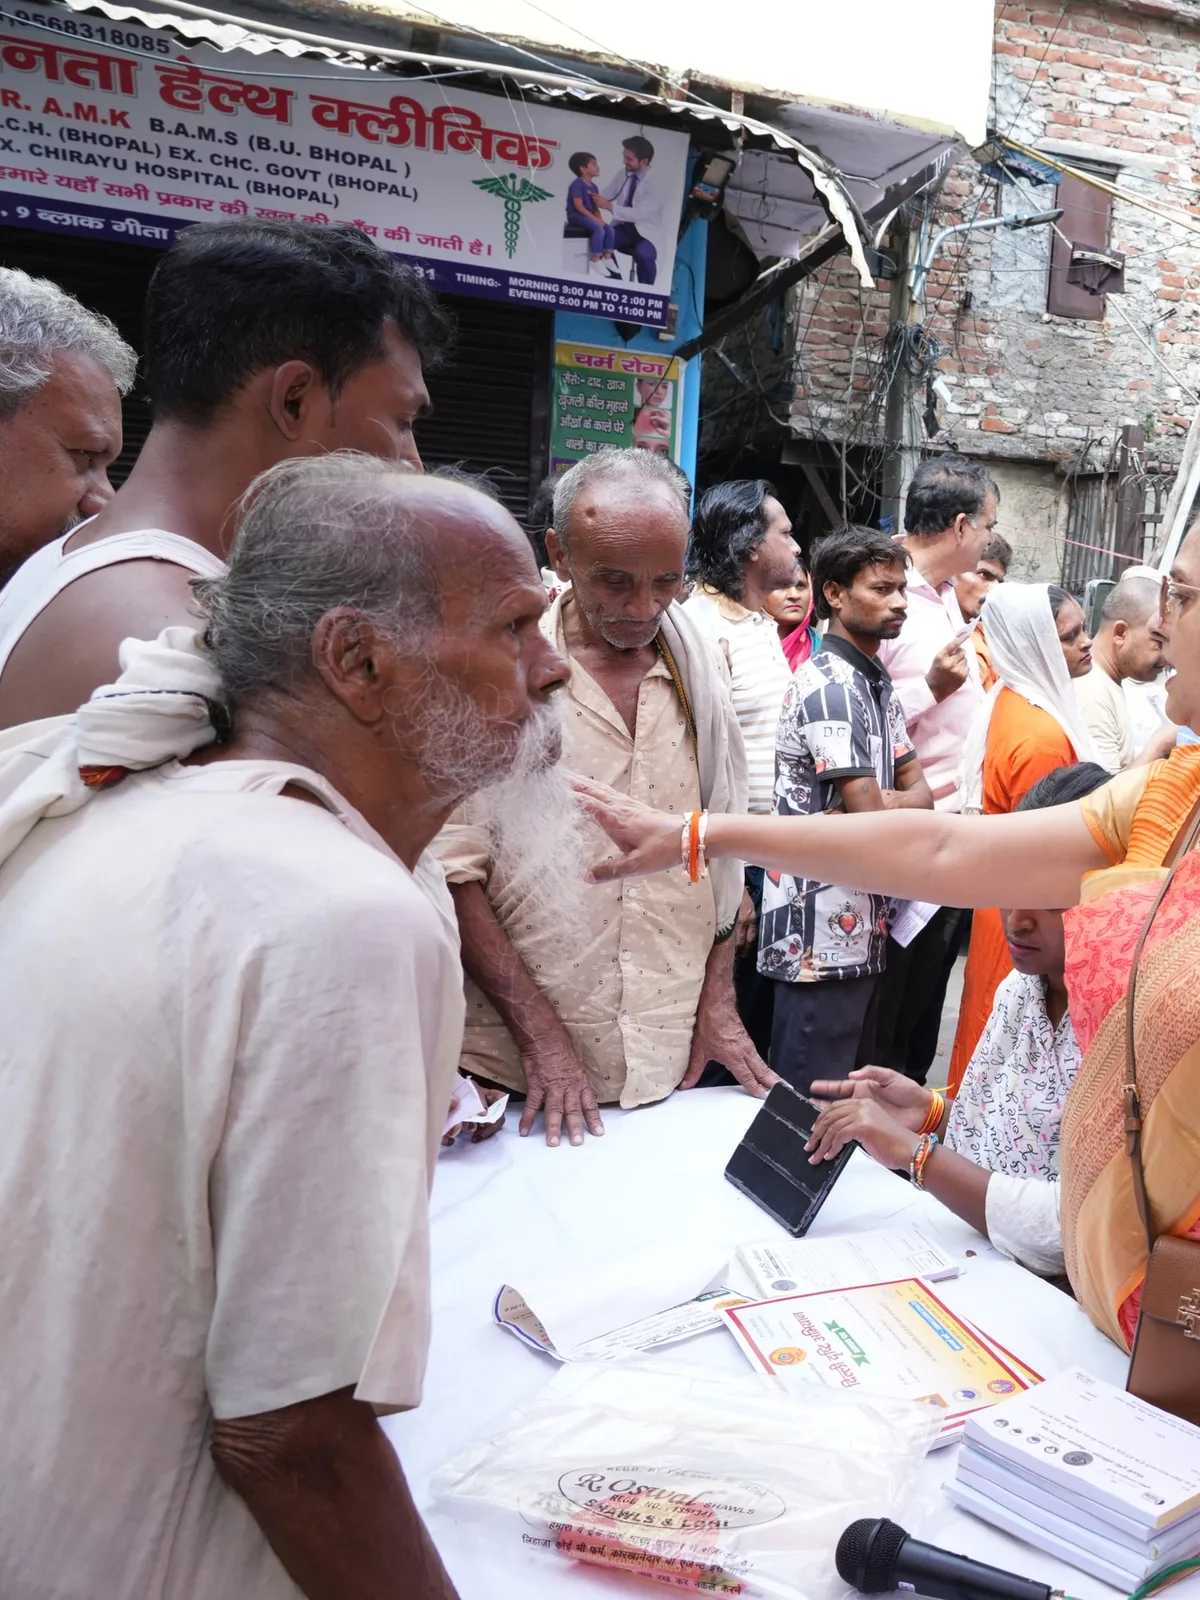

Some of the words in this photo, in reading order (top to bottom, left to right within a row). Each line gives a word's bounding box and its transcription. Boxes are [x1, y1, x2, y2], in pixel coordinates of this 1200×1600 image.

[0, 6, 170, 54] ,9568318085
[0, 34, 140, 96] नता
[155, 55, 293, 124] हेल्थ
[309, 93, 557, 168] क्लीनिक
[0, 88, 31, 111] R.
[42, 97, 131, 129] A.M.K
[149, 117, 238, 146] B.A.M.S
[249, 135, 301, 157] (B.U.
[0, 118, 51, 136] .C.H.
[59, 127, 161, 158] (BHOPAL)
[169, 146, 202, 163] EX.
[210, 154, 259, 172] CHC.
[266, 163, 321, 182] GOVT
[328, 173, 418, 202] (BHOPAL)
[0, 138, 21, 154] X.
[29, 144, 127, 171] CHIRAYU
[136, 161, 239, 190] HOSPITAL
[246, 180, 339, 208] (BHOPAL)
[102, 183, 149, 201] सभी
[156, 191, 215, 211] प्रकार
[219, 199, 249, 216] की
[383, 226, 411, 242] की
[415, 234, 465, 252] जाती
[110, 218, 170, 240] गीता
[509, 277, 559, 293] MORNING
[562, 285, 584, 297] 9:00
[587, 289, 602, 299] AM
[605, 292, 619, 302] TO
[647, 299, 663, 309] PM
[509, 288, 556, 303] EVENING
[559, 297, 580, 307] 5:00
[583, 300, 598, 310] PM
[601, 303, 615, 312] TO
[618, 306, 644, 317] 11:00
[647, 310, 662, 320] PM
[573, 352, 616, 369] चर्म
[621, 356, 665, 376] रोग
[558, 393, 585, 410] खुजली
[829, 1361, 860, 1388] दिल्ली
[584, 1498, 655, 1524] SHAWLS
[661, 1517, 673, 1527] &
[608, 1479, 713, 1506] Oswal
[703, 1502, 756, 1516] SHAWLS
[555, 1539, 573, 1551] कोई
[721, 1583, 741, 1595] करने
